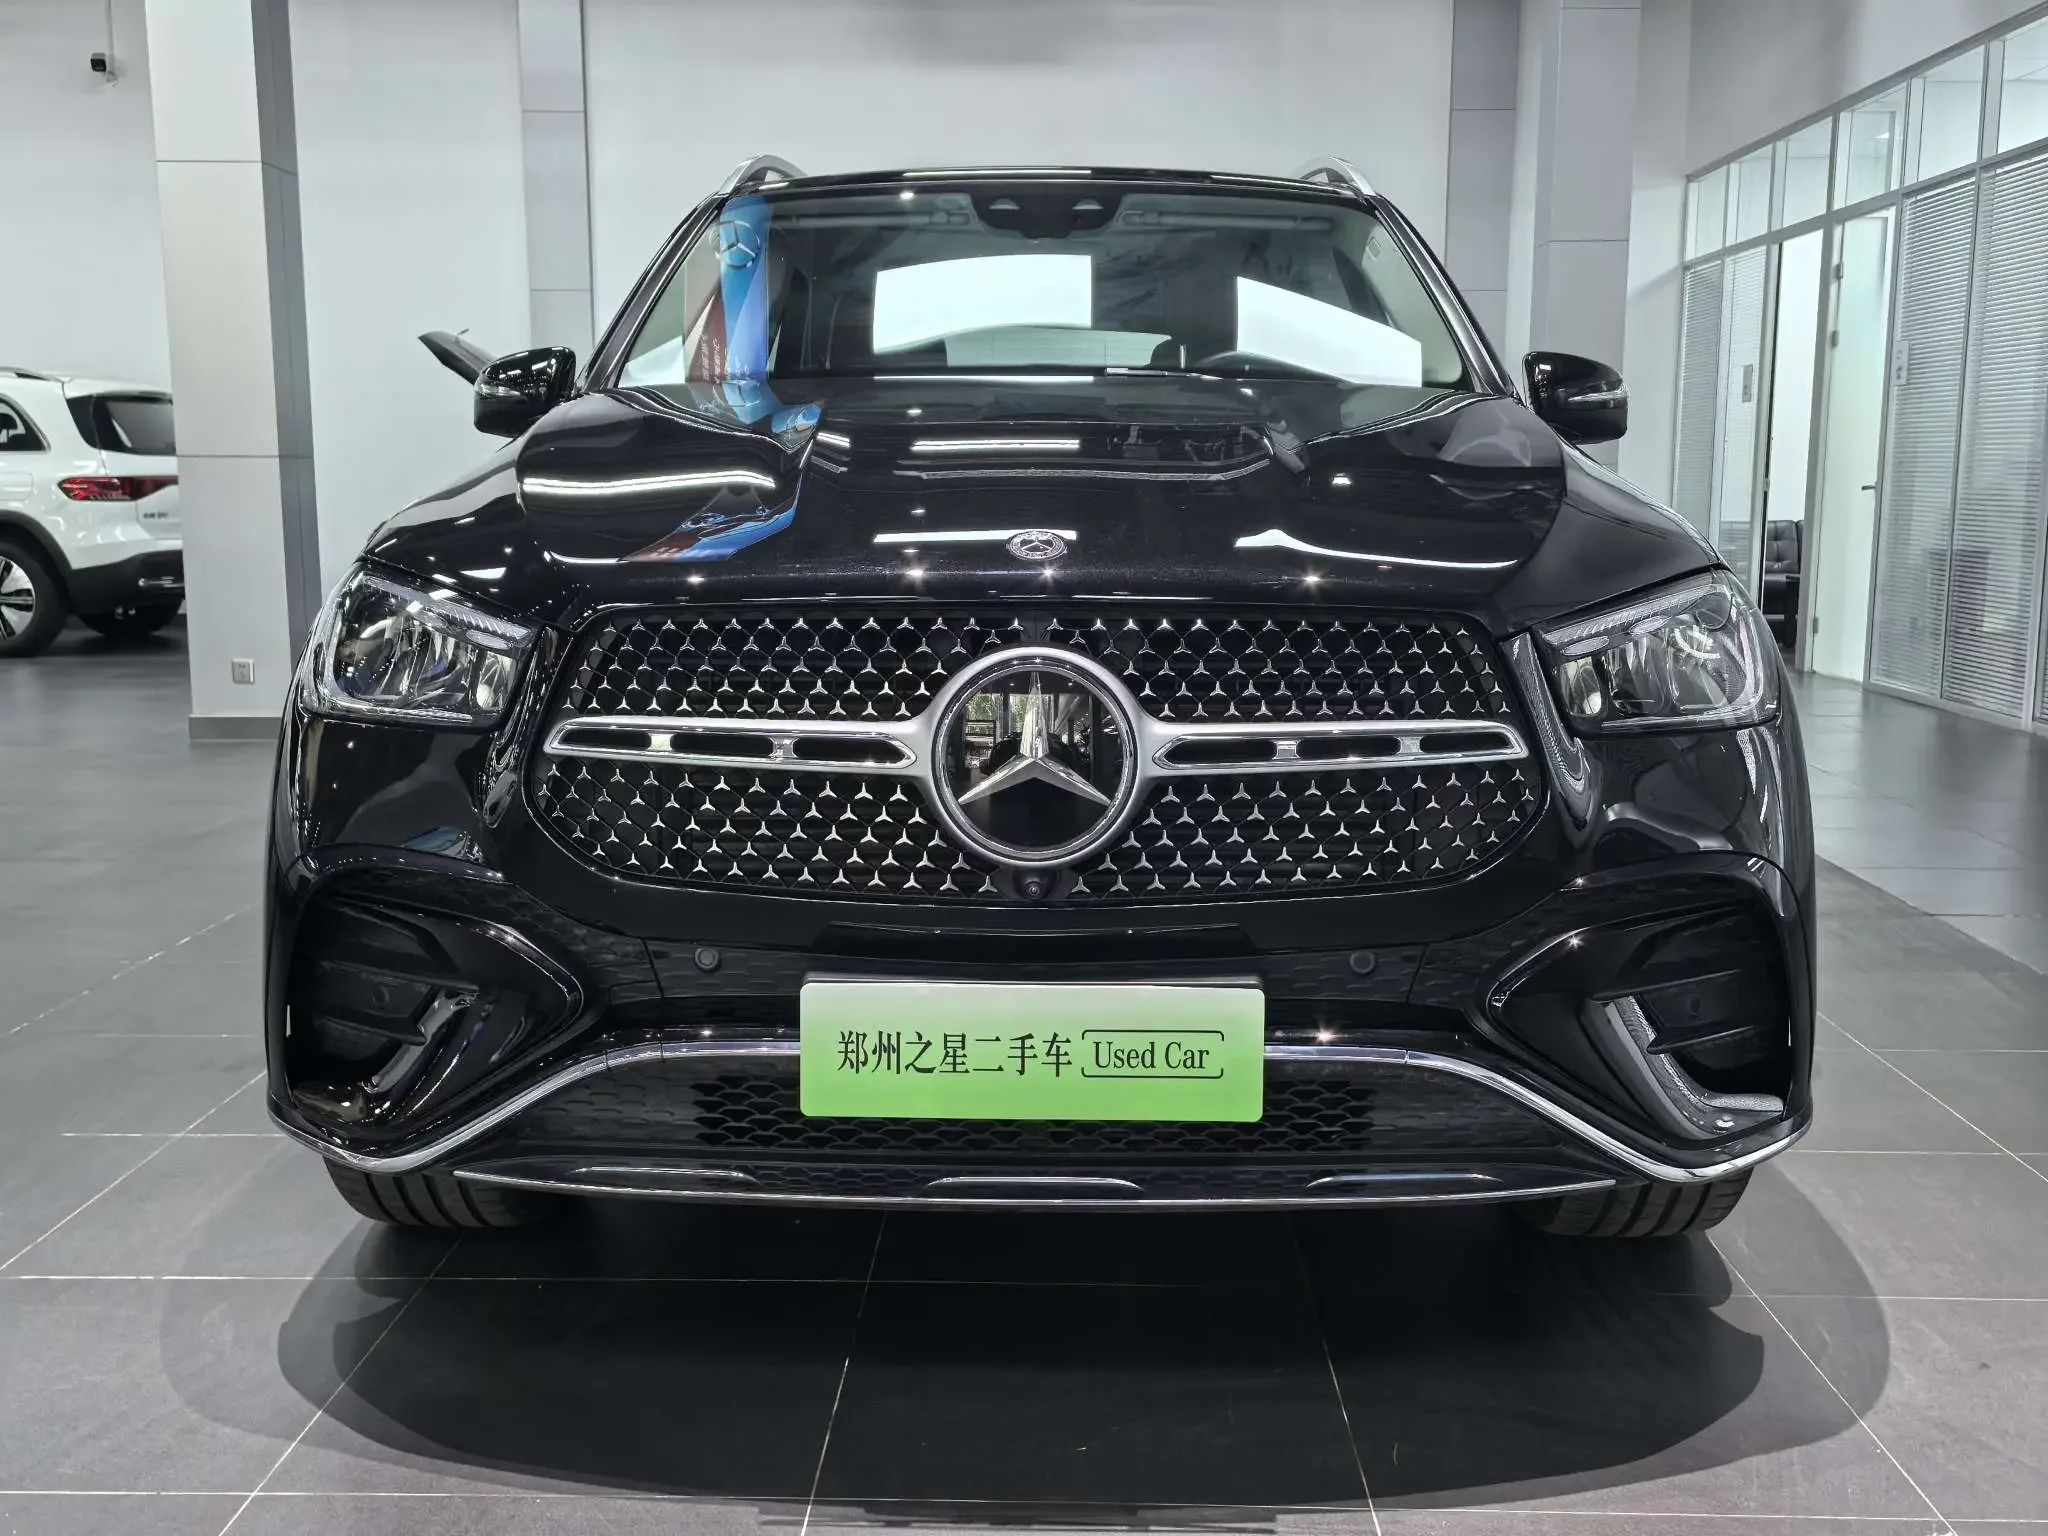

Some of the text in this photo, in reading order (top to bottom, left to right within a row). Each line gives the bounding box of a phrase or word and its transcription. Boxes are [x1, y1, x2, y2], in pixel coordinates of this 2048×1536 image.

[837, 1030, 1073, 1078] 郑州之星二手车
[1093, 1041, 1210, 1070] Used Car
